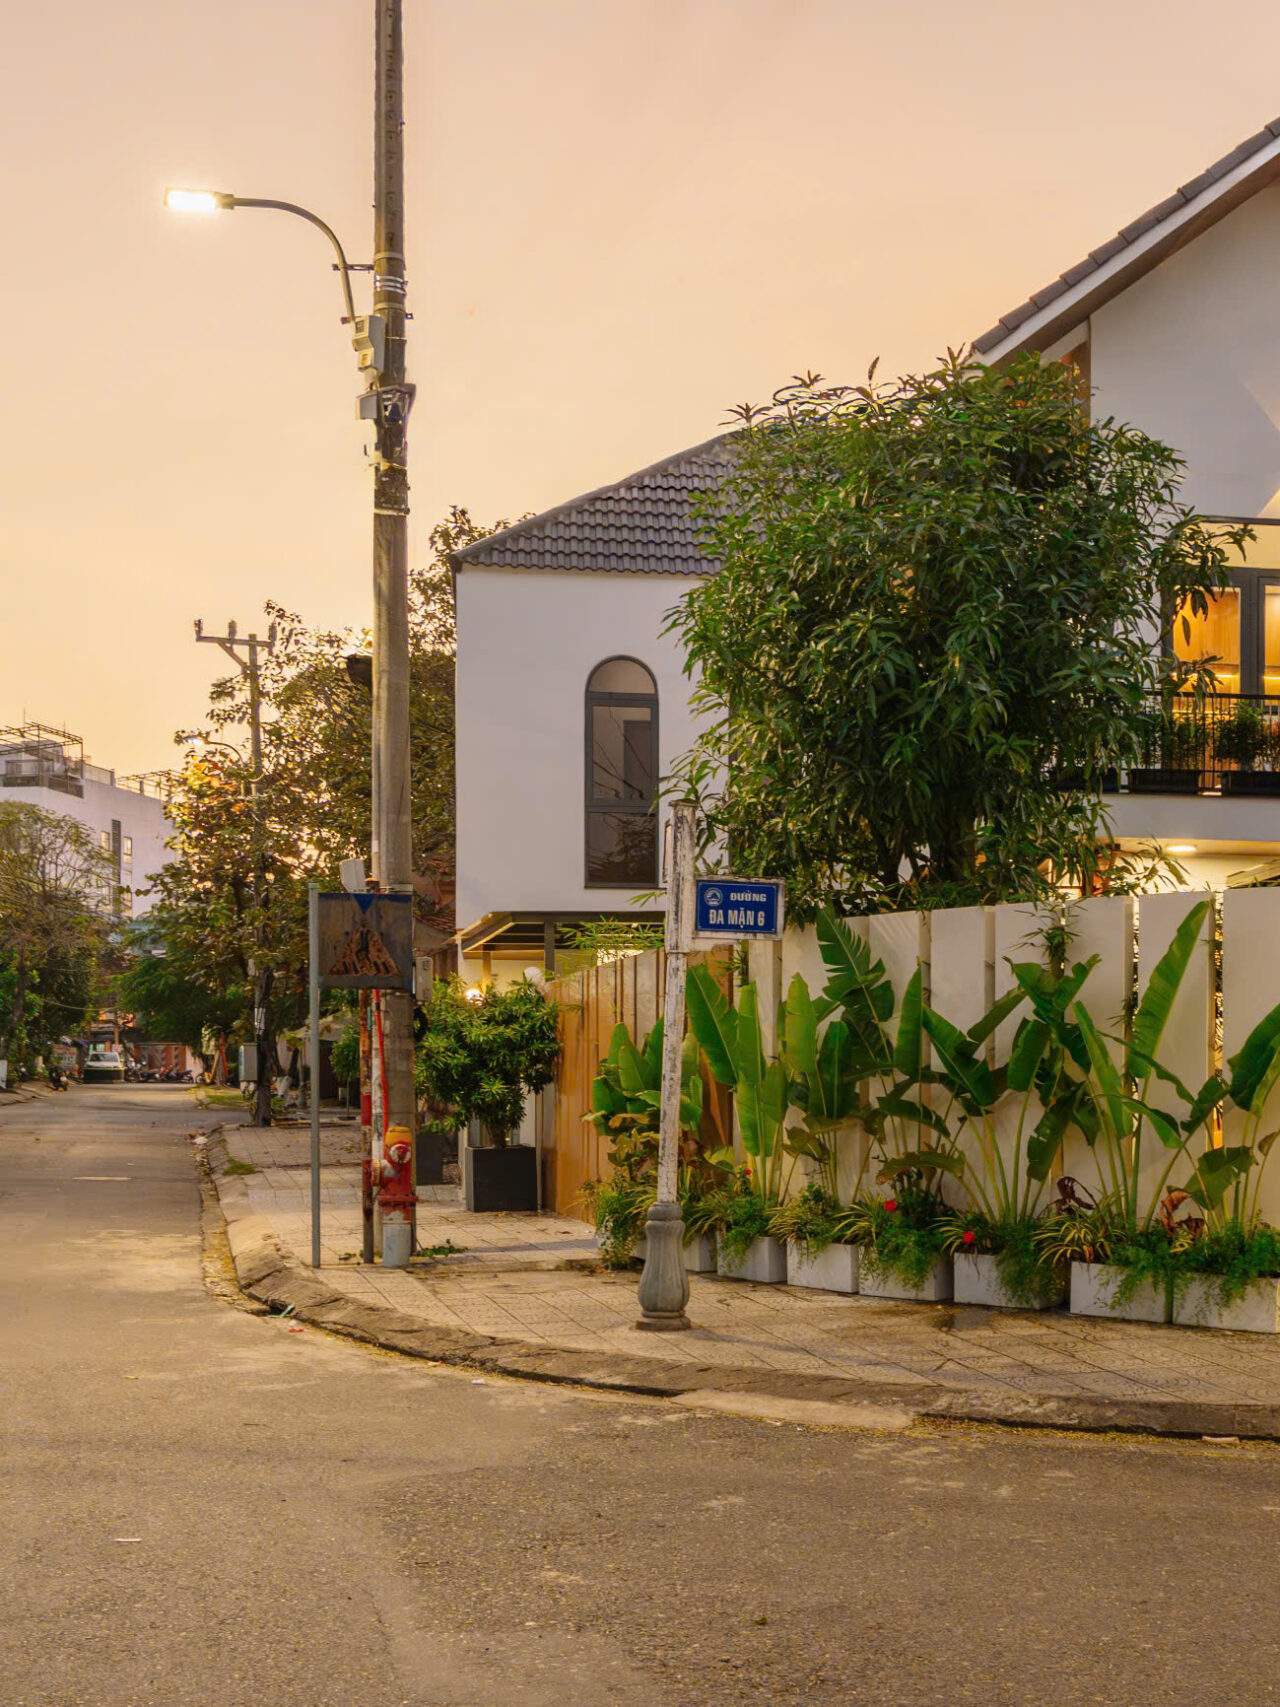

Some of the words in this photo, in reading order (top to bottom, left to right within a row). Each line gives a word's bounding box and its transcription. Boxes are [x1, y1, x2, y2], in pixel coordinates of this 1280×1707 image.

[730, 890, 767, 902] ĐƯỜNG
[709, 909, 724, 925] ĐA
[728, 907, 754, 928] MẶN
